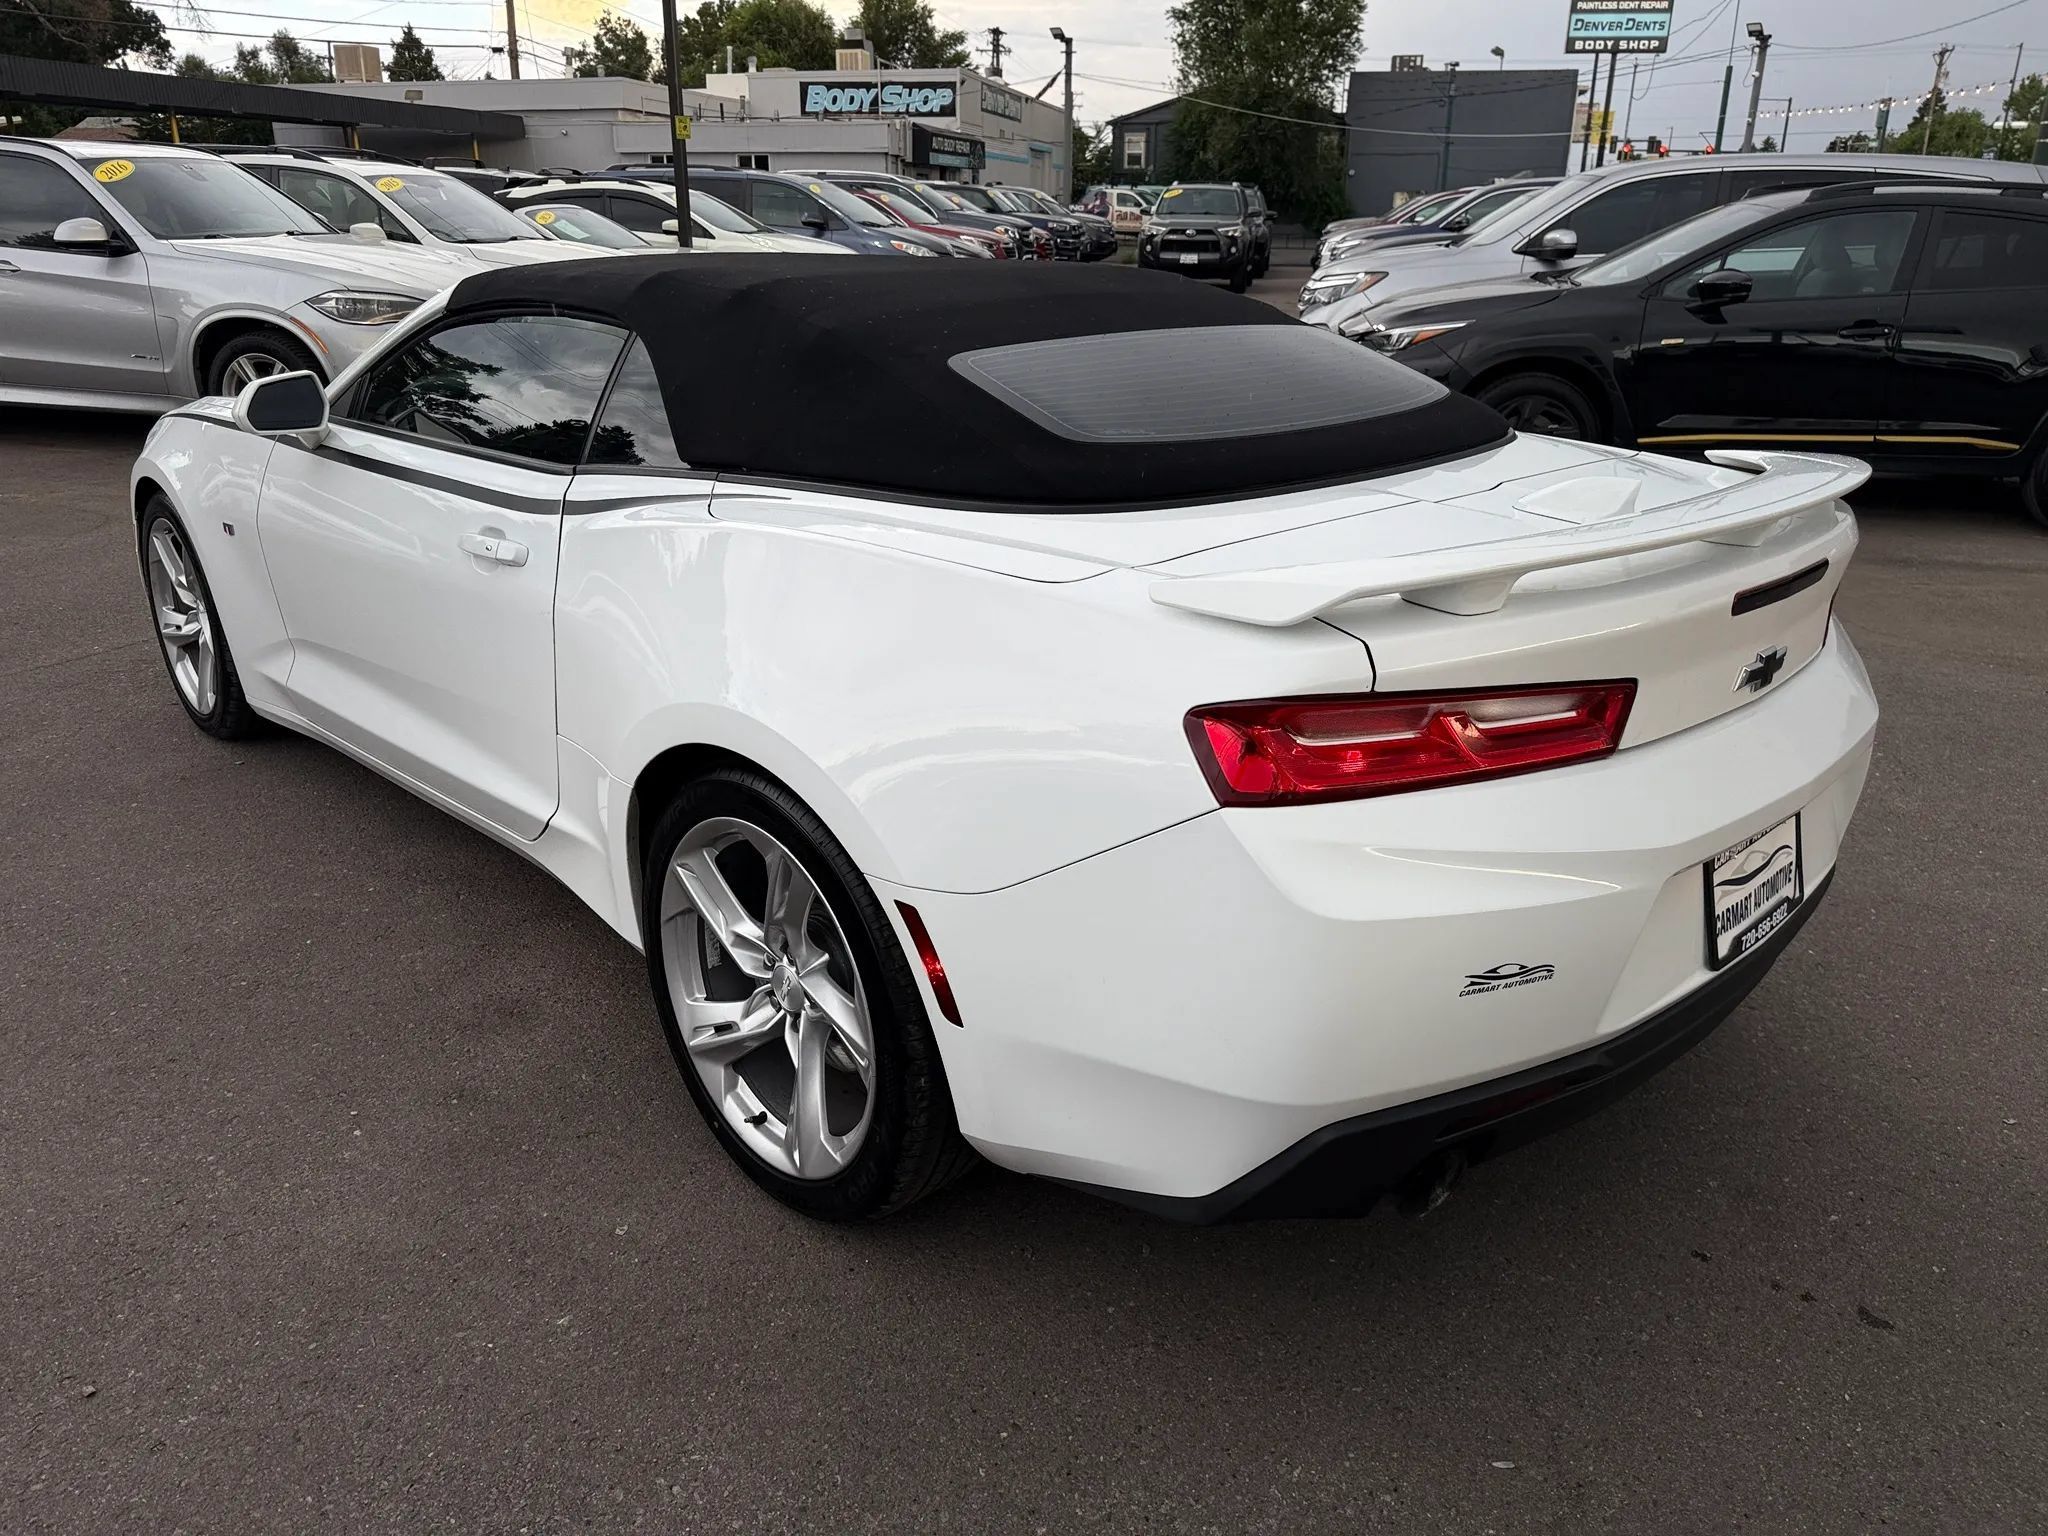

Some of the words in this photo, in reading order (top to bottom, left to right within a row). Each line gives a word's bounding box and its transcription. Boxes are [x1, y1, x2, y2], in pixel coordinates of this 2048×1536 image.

[1577, 1, 1617, 10] PAINTLESS
[1619, 1, 1639, 9] DENT
[1640, 1, 1669, 9] REPAIR
[1575, 40, 1614, 50] BODY
[1618, 40, 1659, 50] SHOP
[805, 85, 878, 112] BODY
[880, 85, 953, 112] SHOP
[100, 161, 128, 180] 2016
[1716, 893, 1752, 937] CARMART
[1753, 860, 1794, 915] AUTOMOTIVE
[1459, 983, 1501, 997] CARMART
[1502, 972, 1554, 990] AUTOMOTIVE
